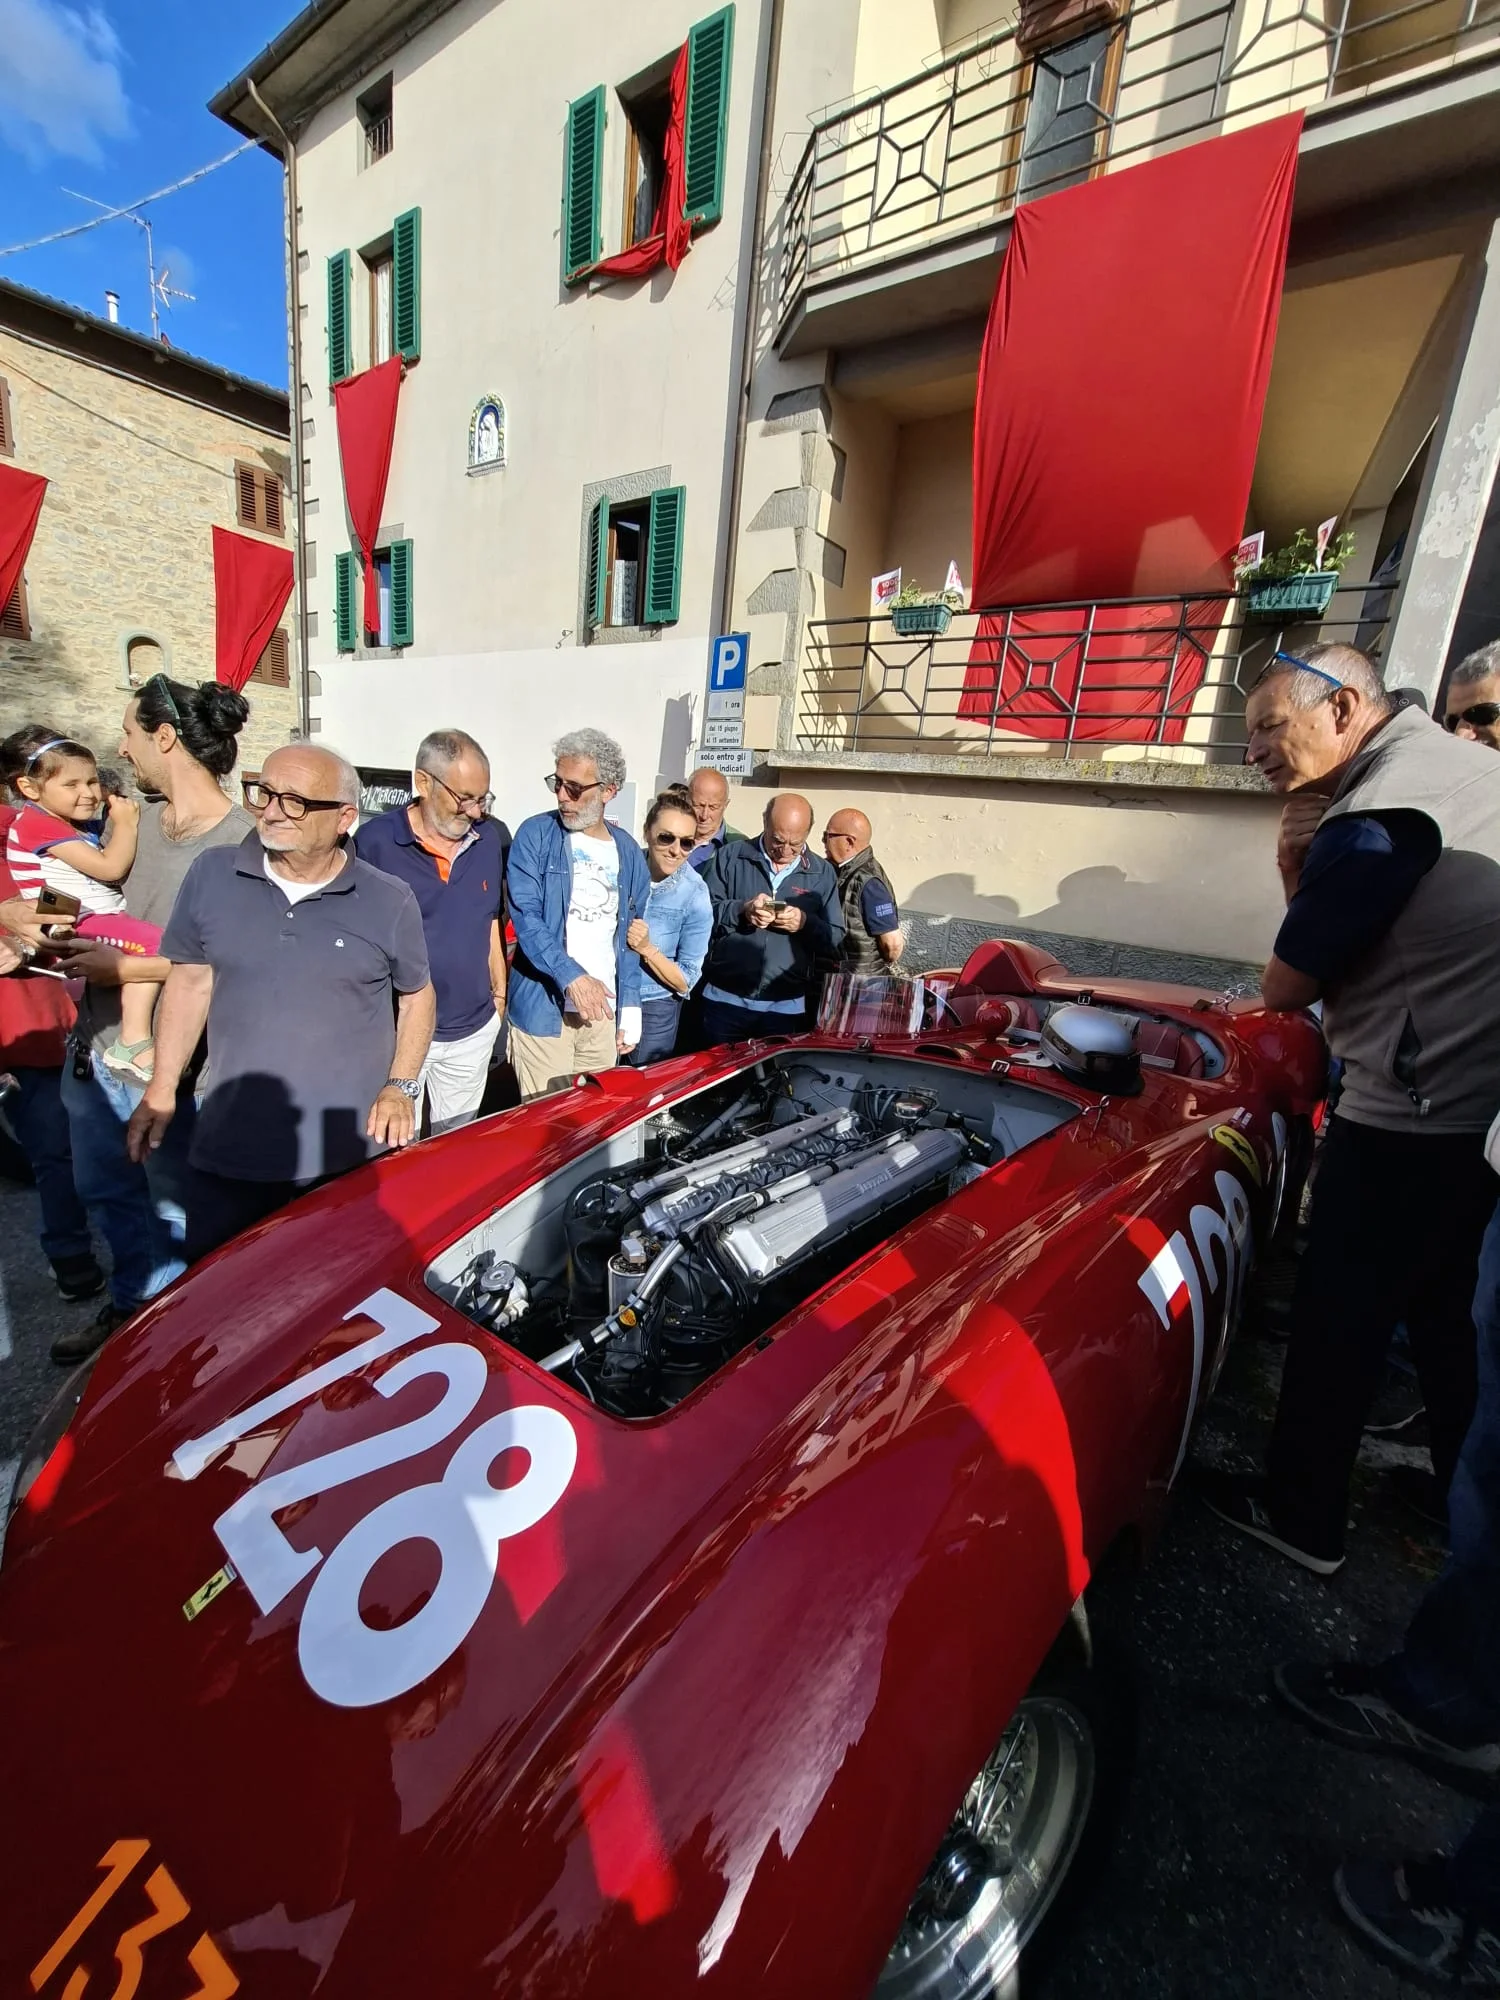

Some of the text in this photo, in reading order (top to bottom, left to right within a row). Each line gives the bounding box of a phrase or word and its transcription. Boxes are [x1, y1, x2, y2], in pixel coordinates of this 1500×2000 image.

[716, 640, 741, 686] P
[700, 753, 746, 762] solo entro gli
[719, 764, 745, 773] indicati
[173, 1287, 578, 1707] 128
